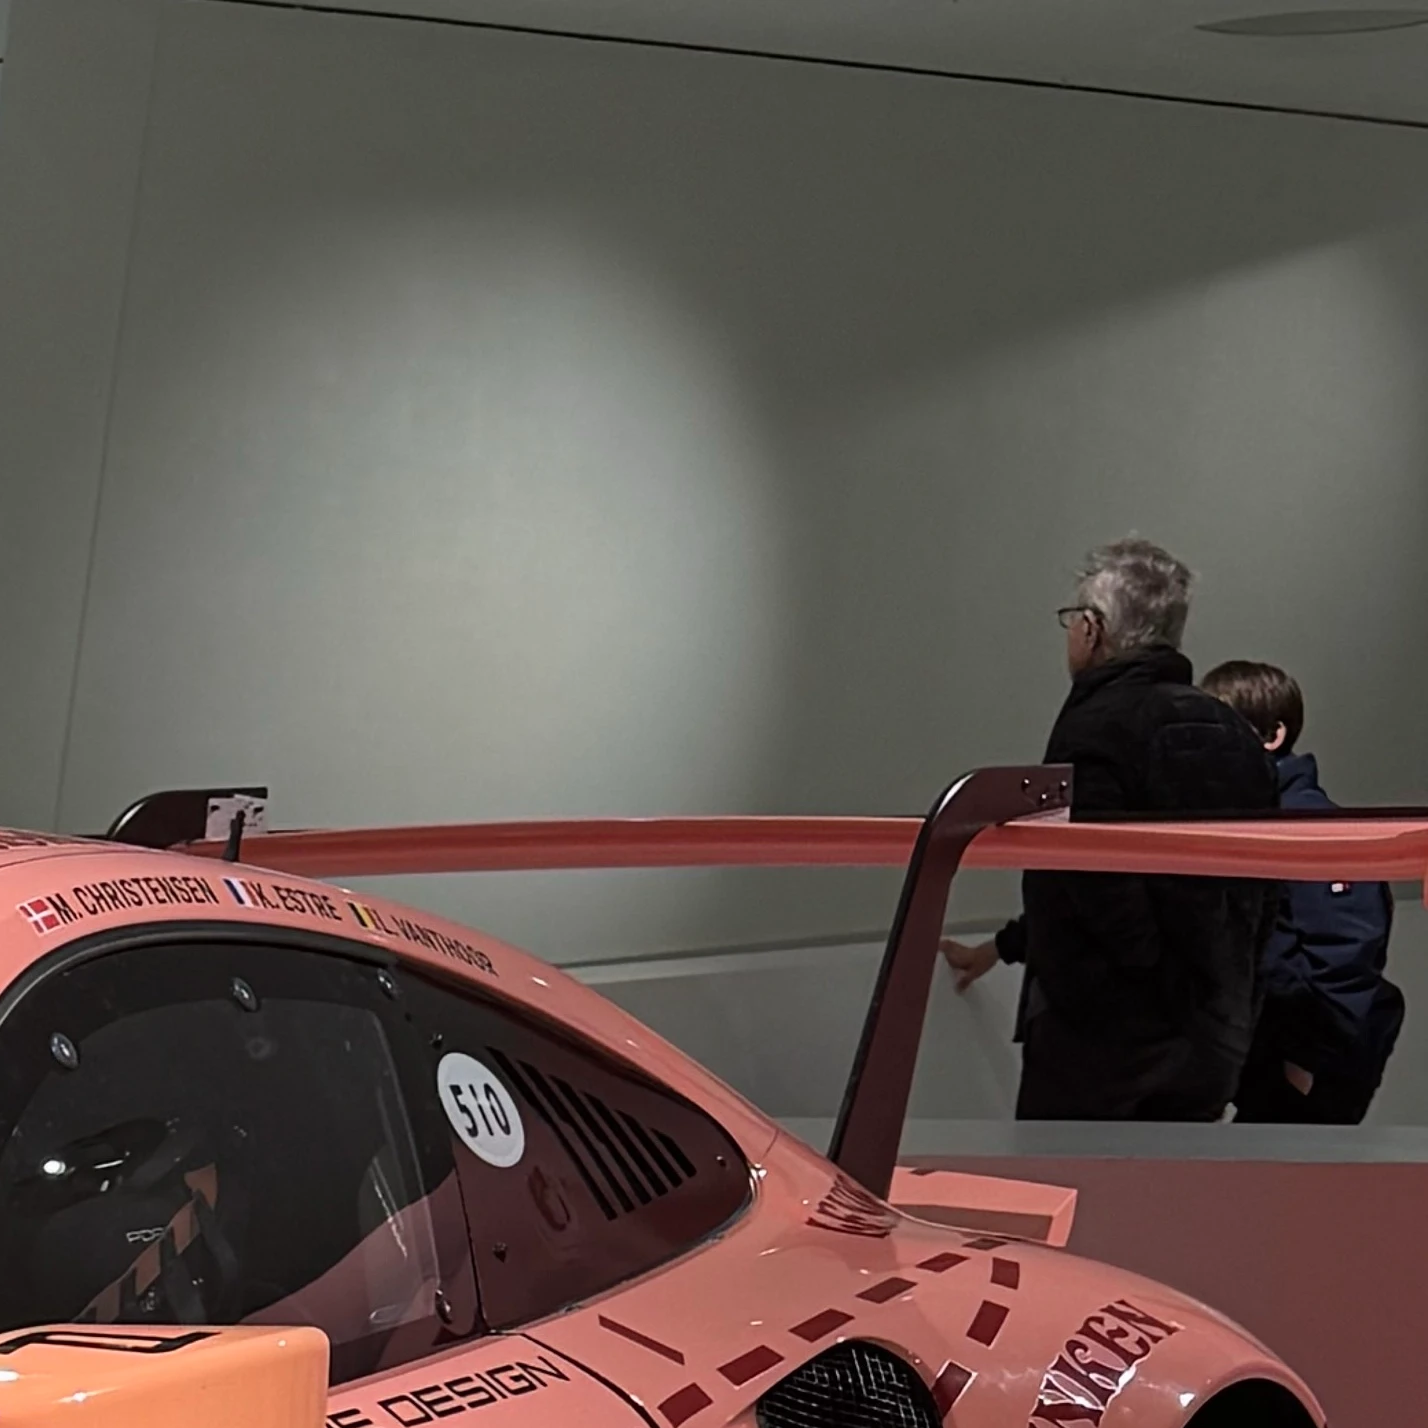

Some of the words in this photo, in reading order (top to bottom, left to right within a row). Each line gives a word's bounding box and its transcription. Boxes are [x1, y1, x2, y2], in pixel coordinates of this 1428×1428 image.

[73, 876, 220, 915] CHRISTENSEN
[276, 884, 343, 922] ESTRE
[382, 1355, 571, 1428] DESIGN
